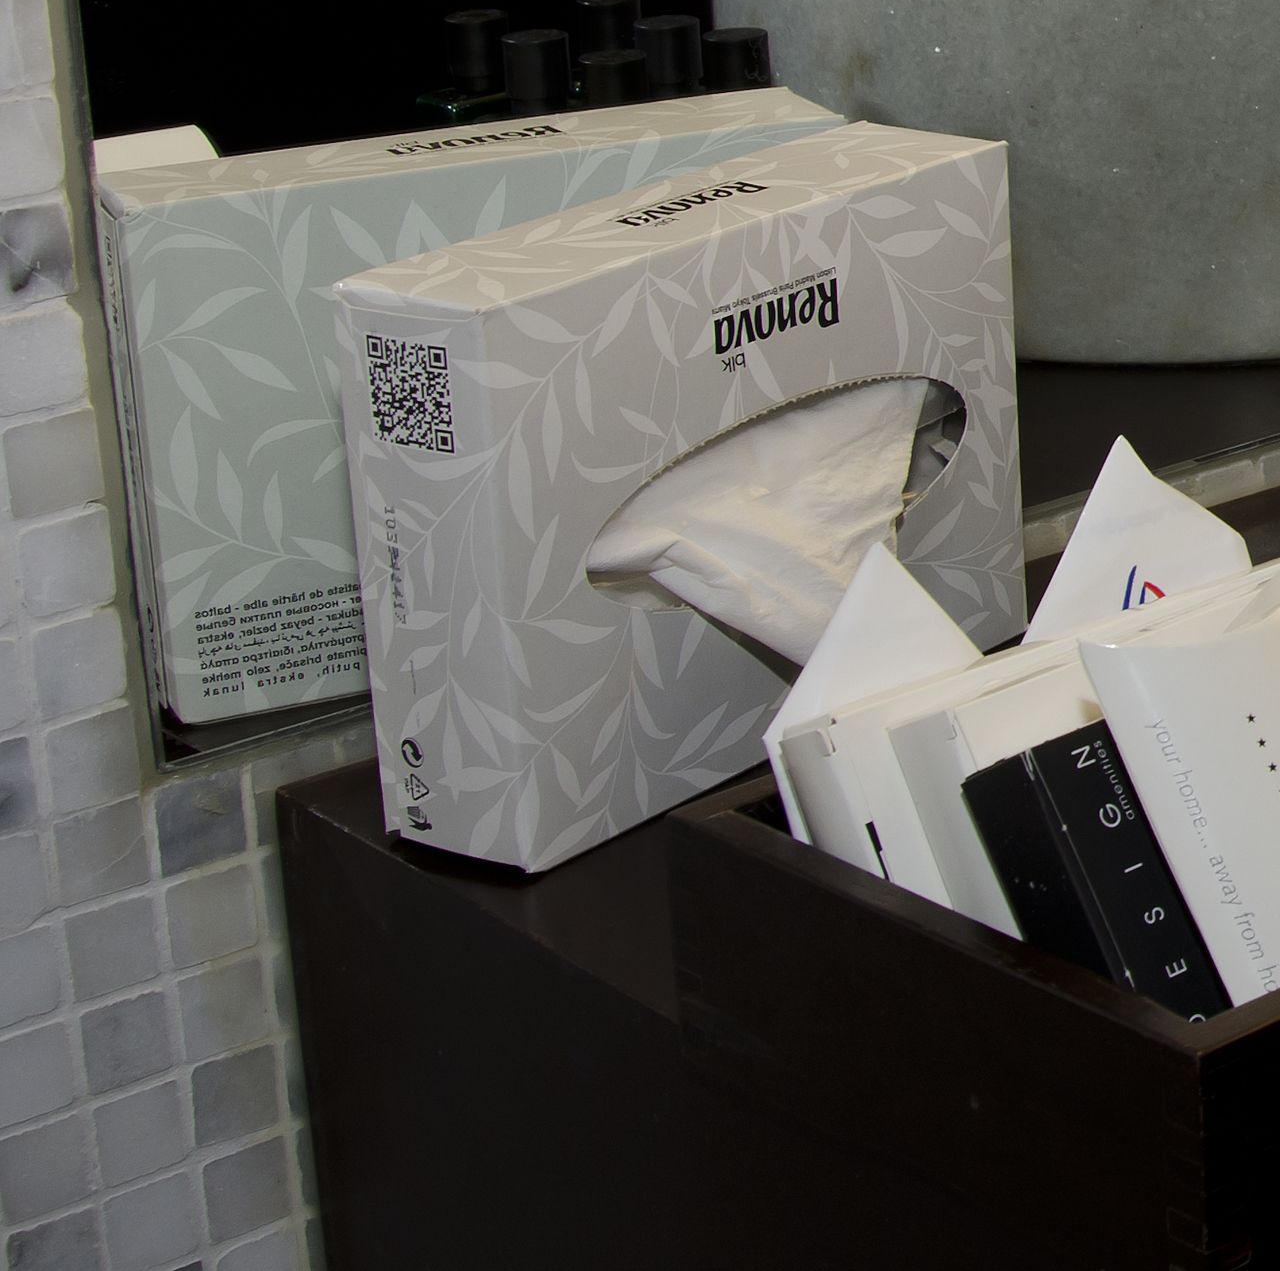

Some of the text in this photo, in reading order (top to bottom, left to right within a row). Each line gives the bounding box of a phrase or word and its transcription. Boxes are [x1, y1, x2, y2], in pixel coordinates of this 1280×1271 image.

[615, 181, 770, 227] Renova
[714, 278, 840, 355] Renova
[722, 352, 747, 373] blk
[1094, 740, 1135, 821] amenities
[1144, 718, 1182, 764] your
[1209, 854, 1243, 905] away
[1234, 912, 1265, 960] from
[1258, 964, 1280, 993] ho
